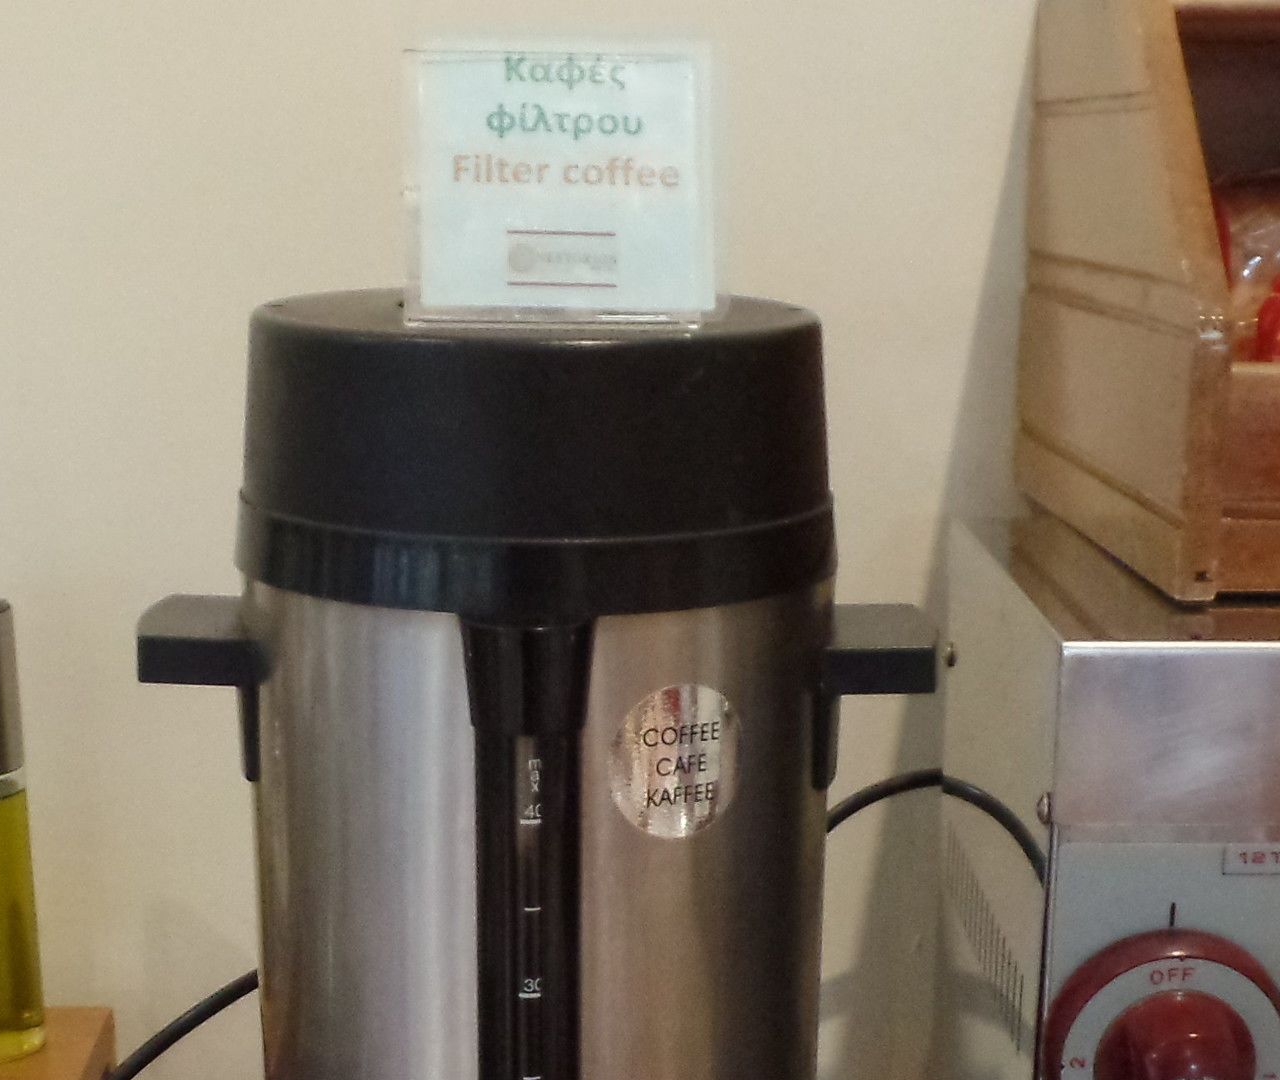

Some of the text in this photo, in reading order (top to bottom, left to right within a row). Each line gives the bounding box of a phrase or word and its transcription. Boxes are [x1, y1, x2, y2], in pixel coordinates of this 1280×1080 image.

[504, 55, 627, 90] Καφές
[486, 103, 644, 140] φίλτρου
[452, 154, 680, 187] Filter coffee
[642, 721, 721, 747] COFFEE
[656, 753, 708, 777] CAFE
[646, 781, 716, 808] KAFFEE
[1149, 967, 1195, 985] OFF
